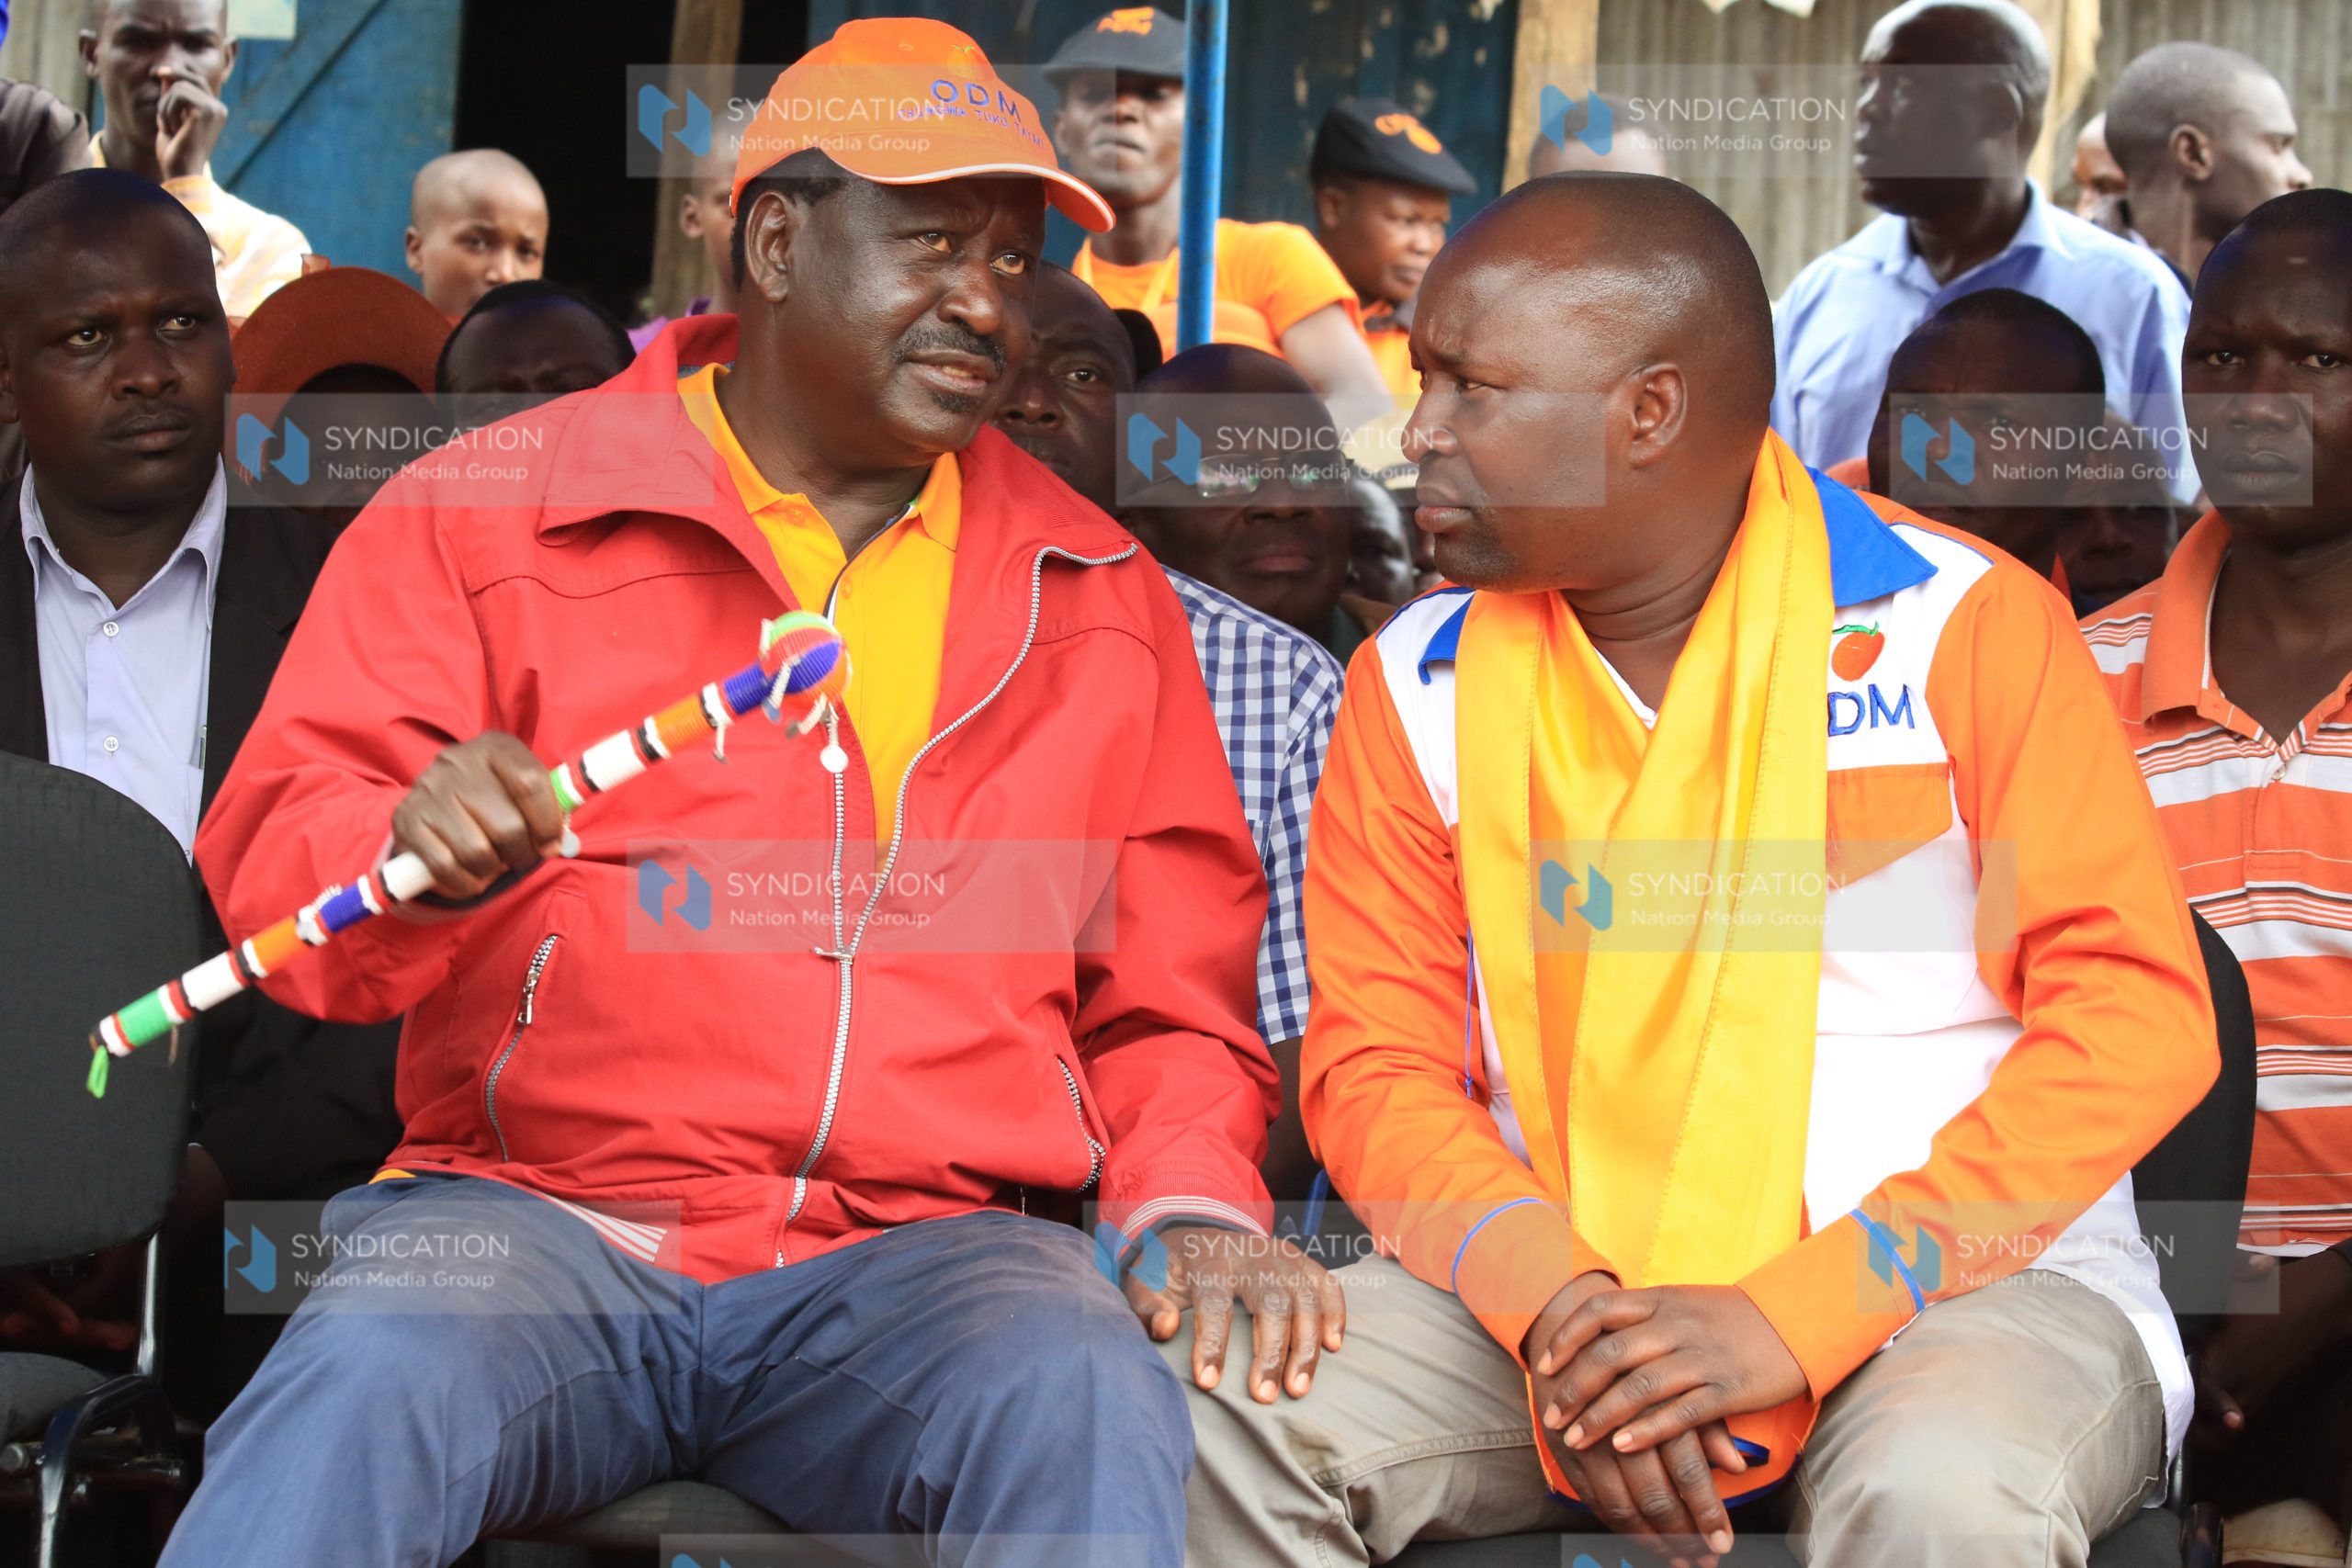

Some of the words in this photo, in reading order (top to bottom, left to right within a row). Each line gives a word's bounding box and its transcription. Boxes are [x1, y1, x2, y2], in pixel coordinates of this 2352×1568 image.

[930, 79, 1023, 122] ODM
[975, 109, 1009, 127] TUKO
[1826, 682, 1916, 737] DM
